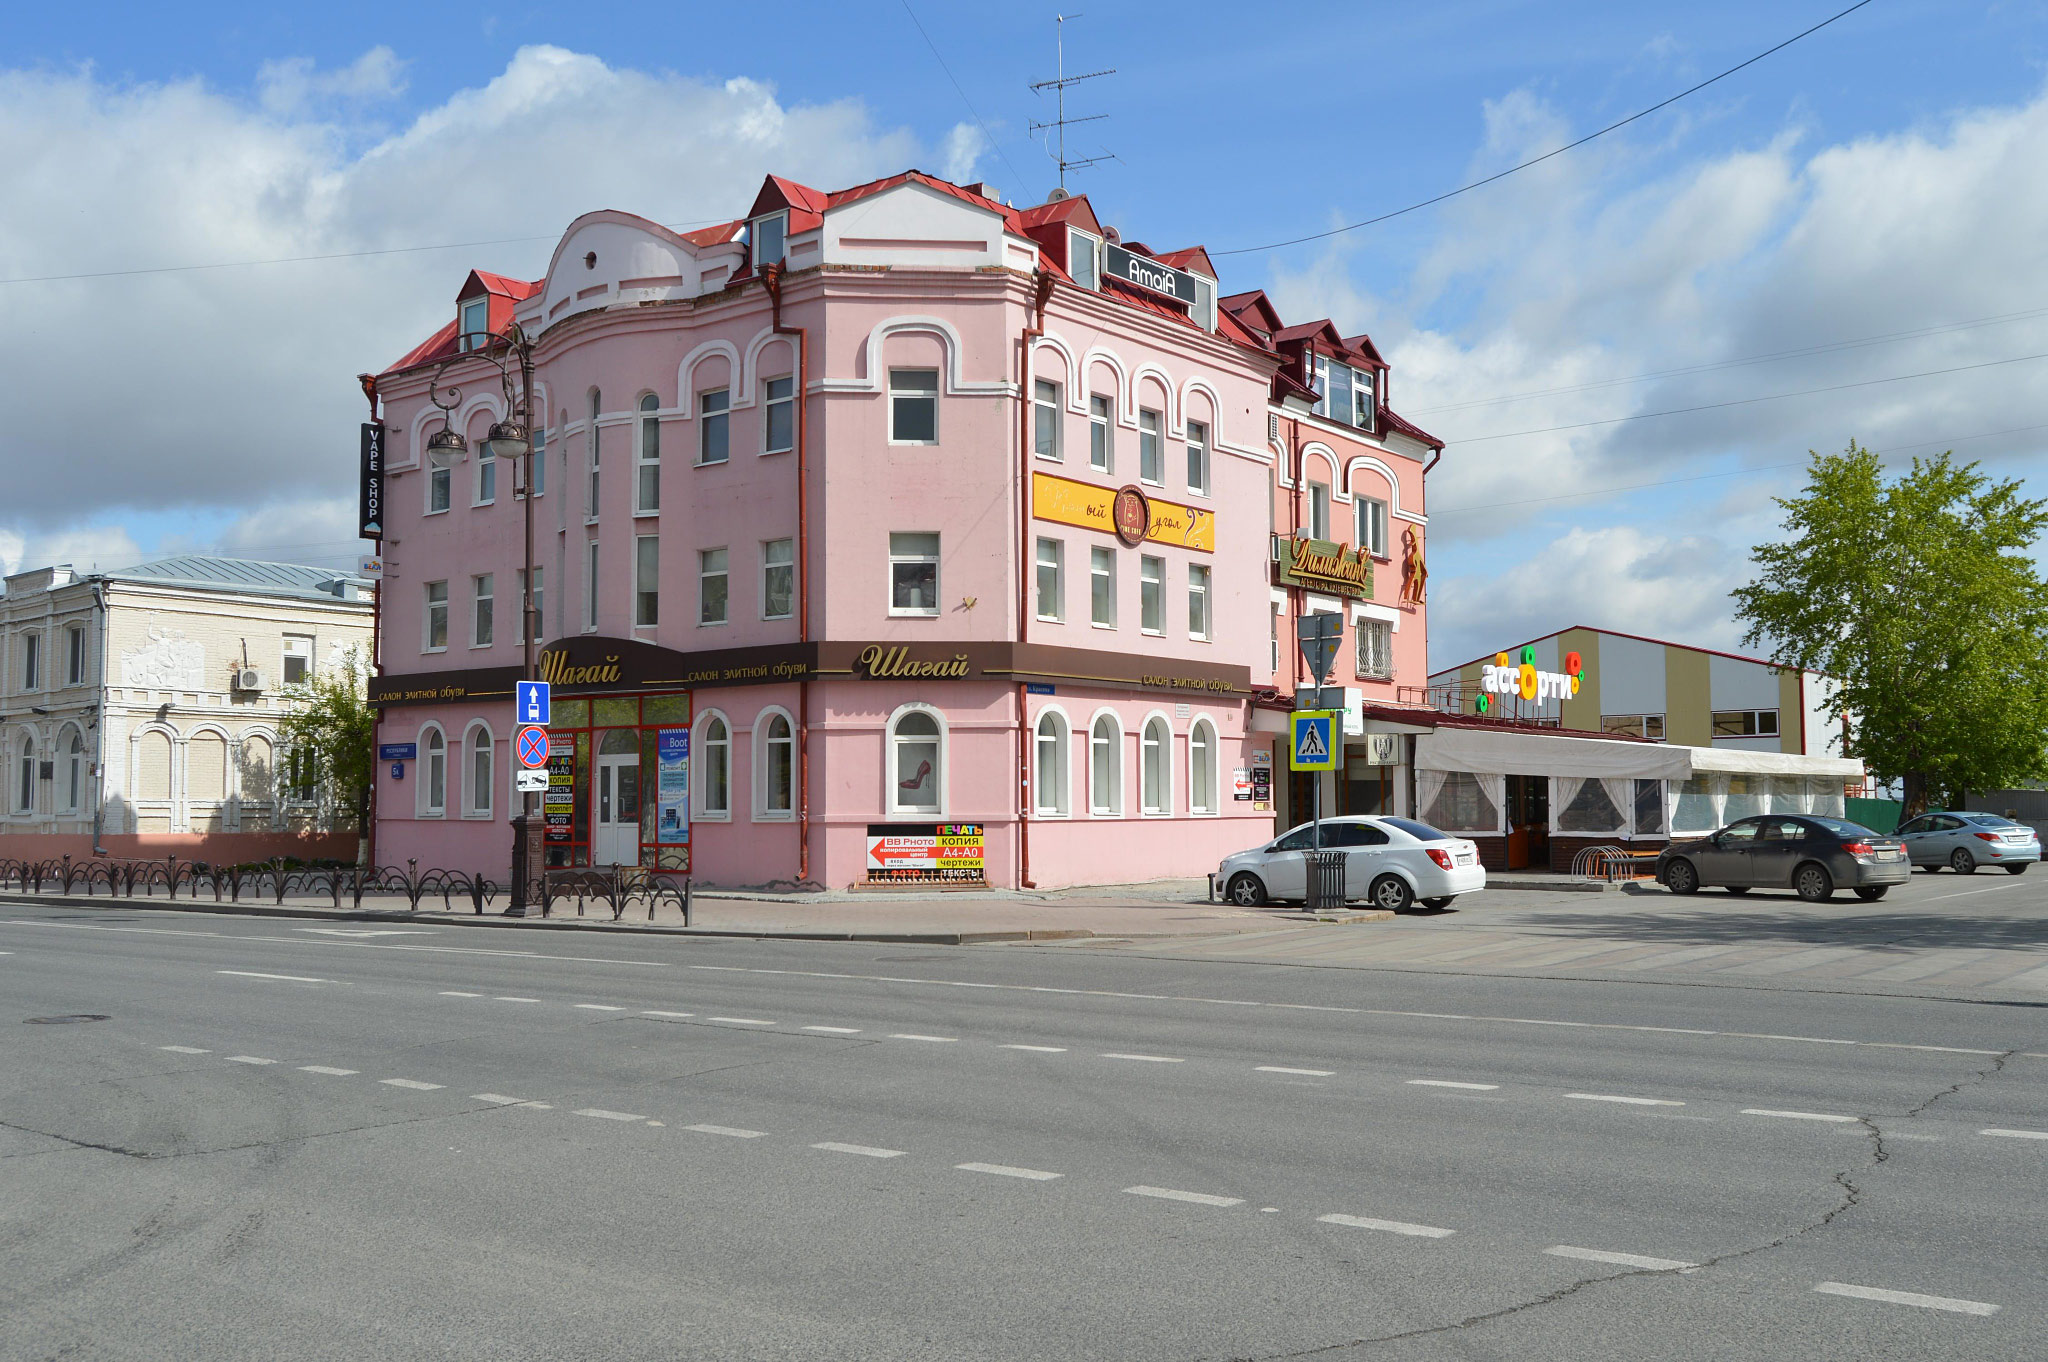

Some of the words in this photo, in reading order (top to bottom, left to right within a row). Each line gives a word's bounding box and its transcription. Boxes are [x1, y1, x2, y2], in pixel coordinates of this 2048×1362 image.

[1129, 259, 1176, 296] AmaiA
[370, 430, 379, 471] VAPE
[369, 478, 378, 518] SHOP
[861, 644, 970, 677] Шагай
[540, 650, 622, 686] Шагай
[688, 670, 719, 681] САЛОН
[724, 664, 768, 680] ЭЛИТНОЙ
[1143, 674, 1169, 686] САЛОН
[1172, 677, 1206, 689] ЭЛИТНОЙ
[379, 691, 402, 701] САЛОН
[405, 688, 437, 700] ЭЛИТНОЙ
[548, 757, 573, 766] ПЕЧАТЬ
[546, 795, 573, 803] чертежи
[936, 824, 983, 835] ПЕЧАТЬ
[886, 838, 901, 846] BB
[941, 837, 979, 846] КОПИЯ
[880, 846, 929, 854] копировальный
[943, 847, 978, 857] A4-A0
[940, 859, 981, 868] чертежи
[891, 869, 921, 877] ФОТО
[943, 869, 980, 877] ТЕКСТЫ
